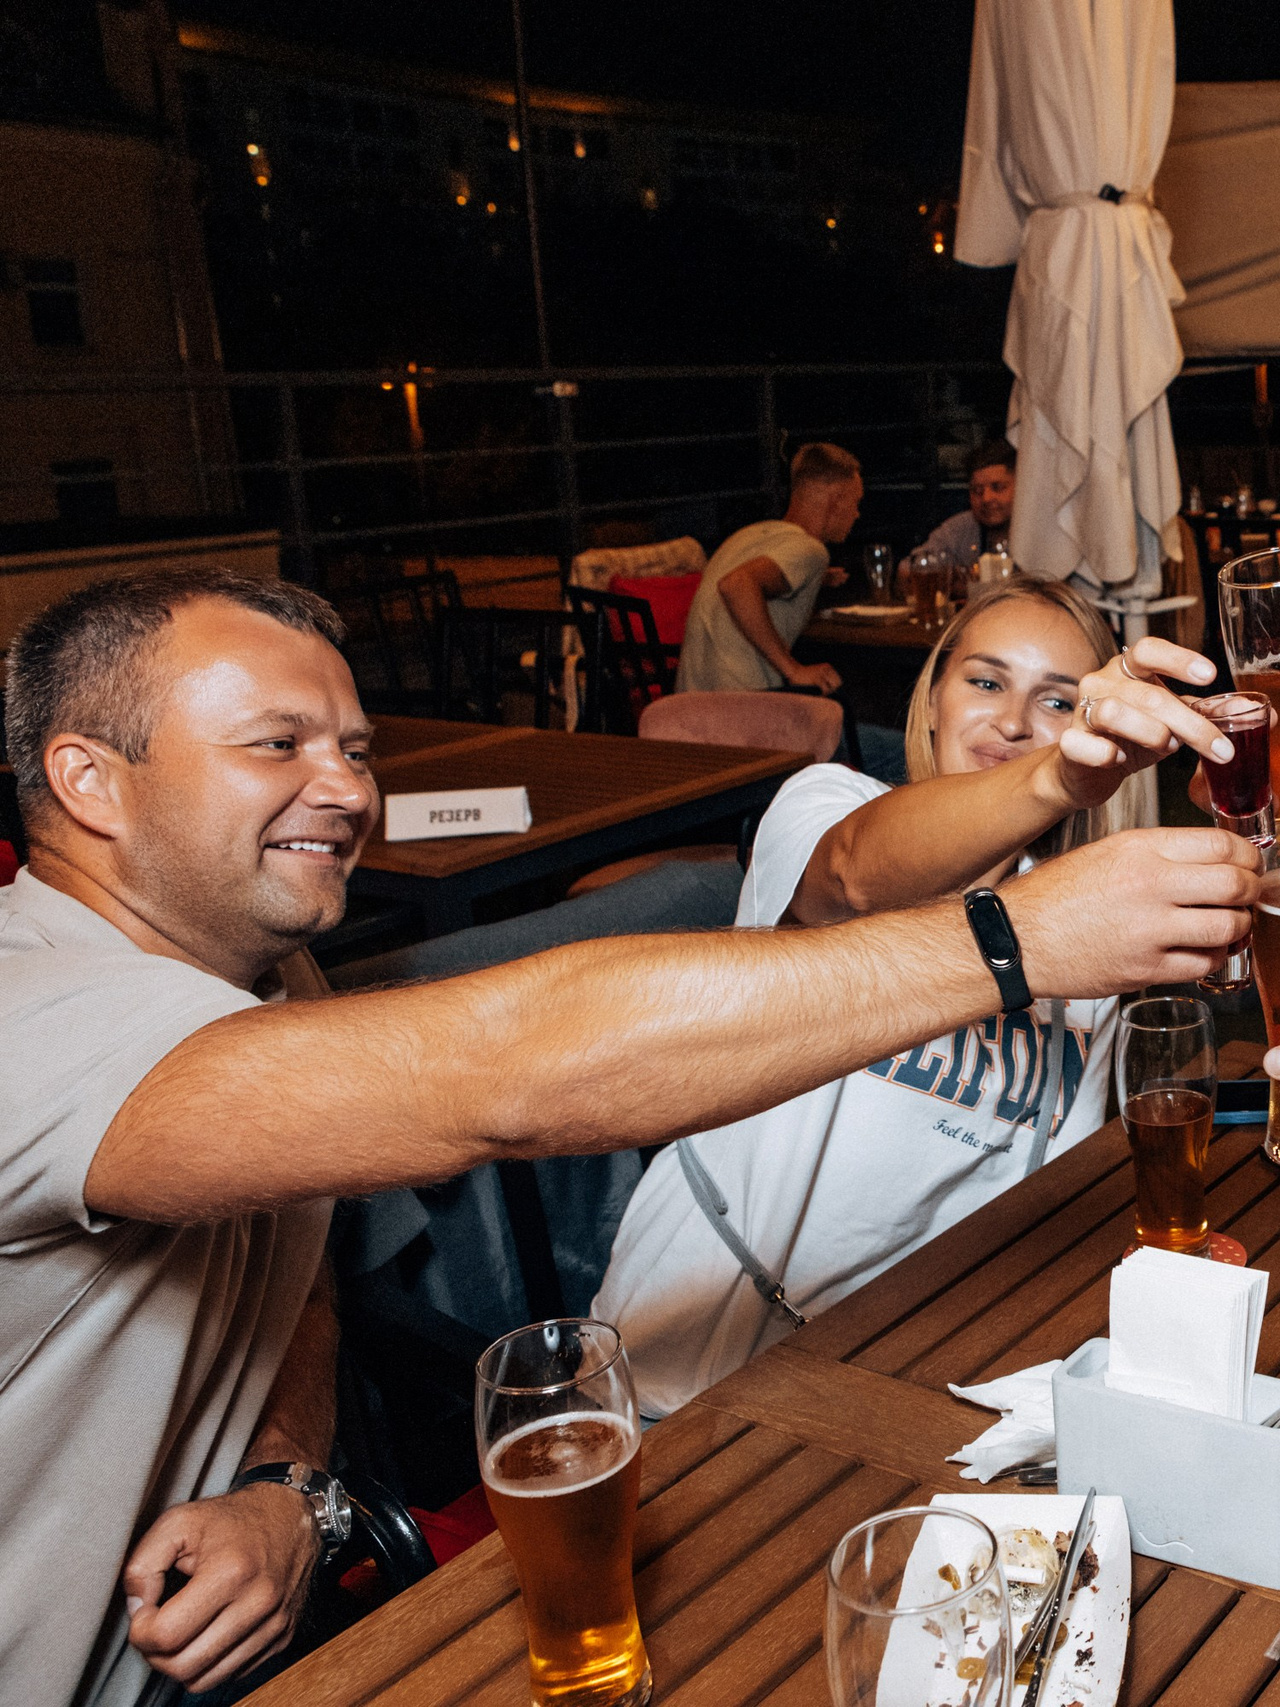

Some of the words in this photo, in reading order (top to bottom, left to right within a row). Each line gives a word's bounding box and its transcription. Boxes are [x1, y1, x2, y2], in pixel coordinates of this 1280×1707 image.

[429, 808, 481, 823] РЕЗЕРВ
[932, 1119, 963, 1139] Feel
[961, 1131, 981, 1148] the
